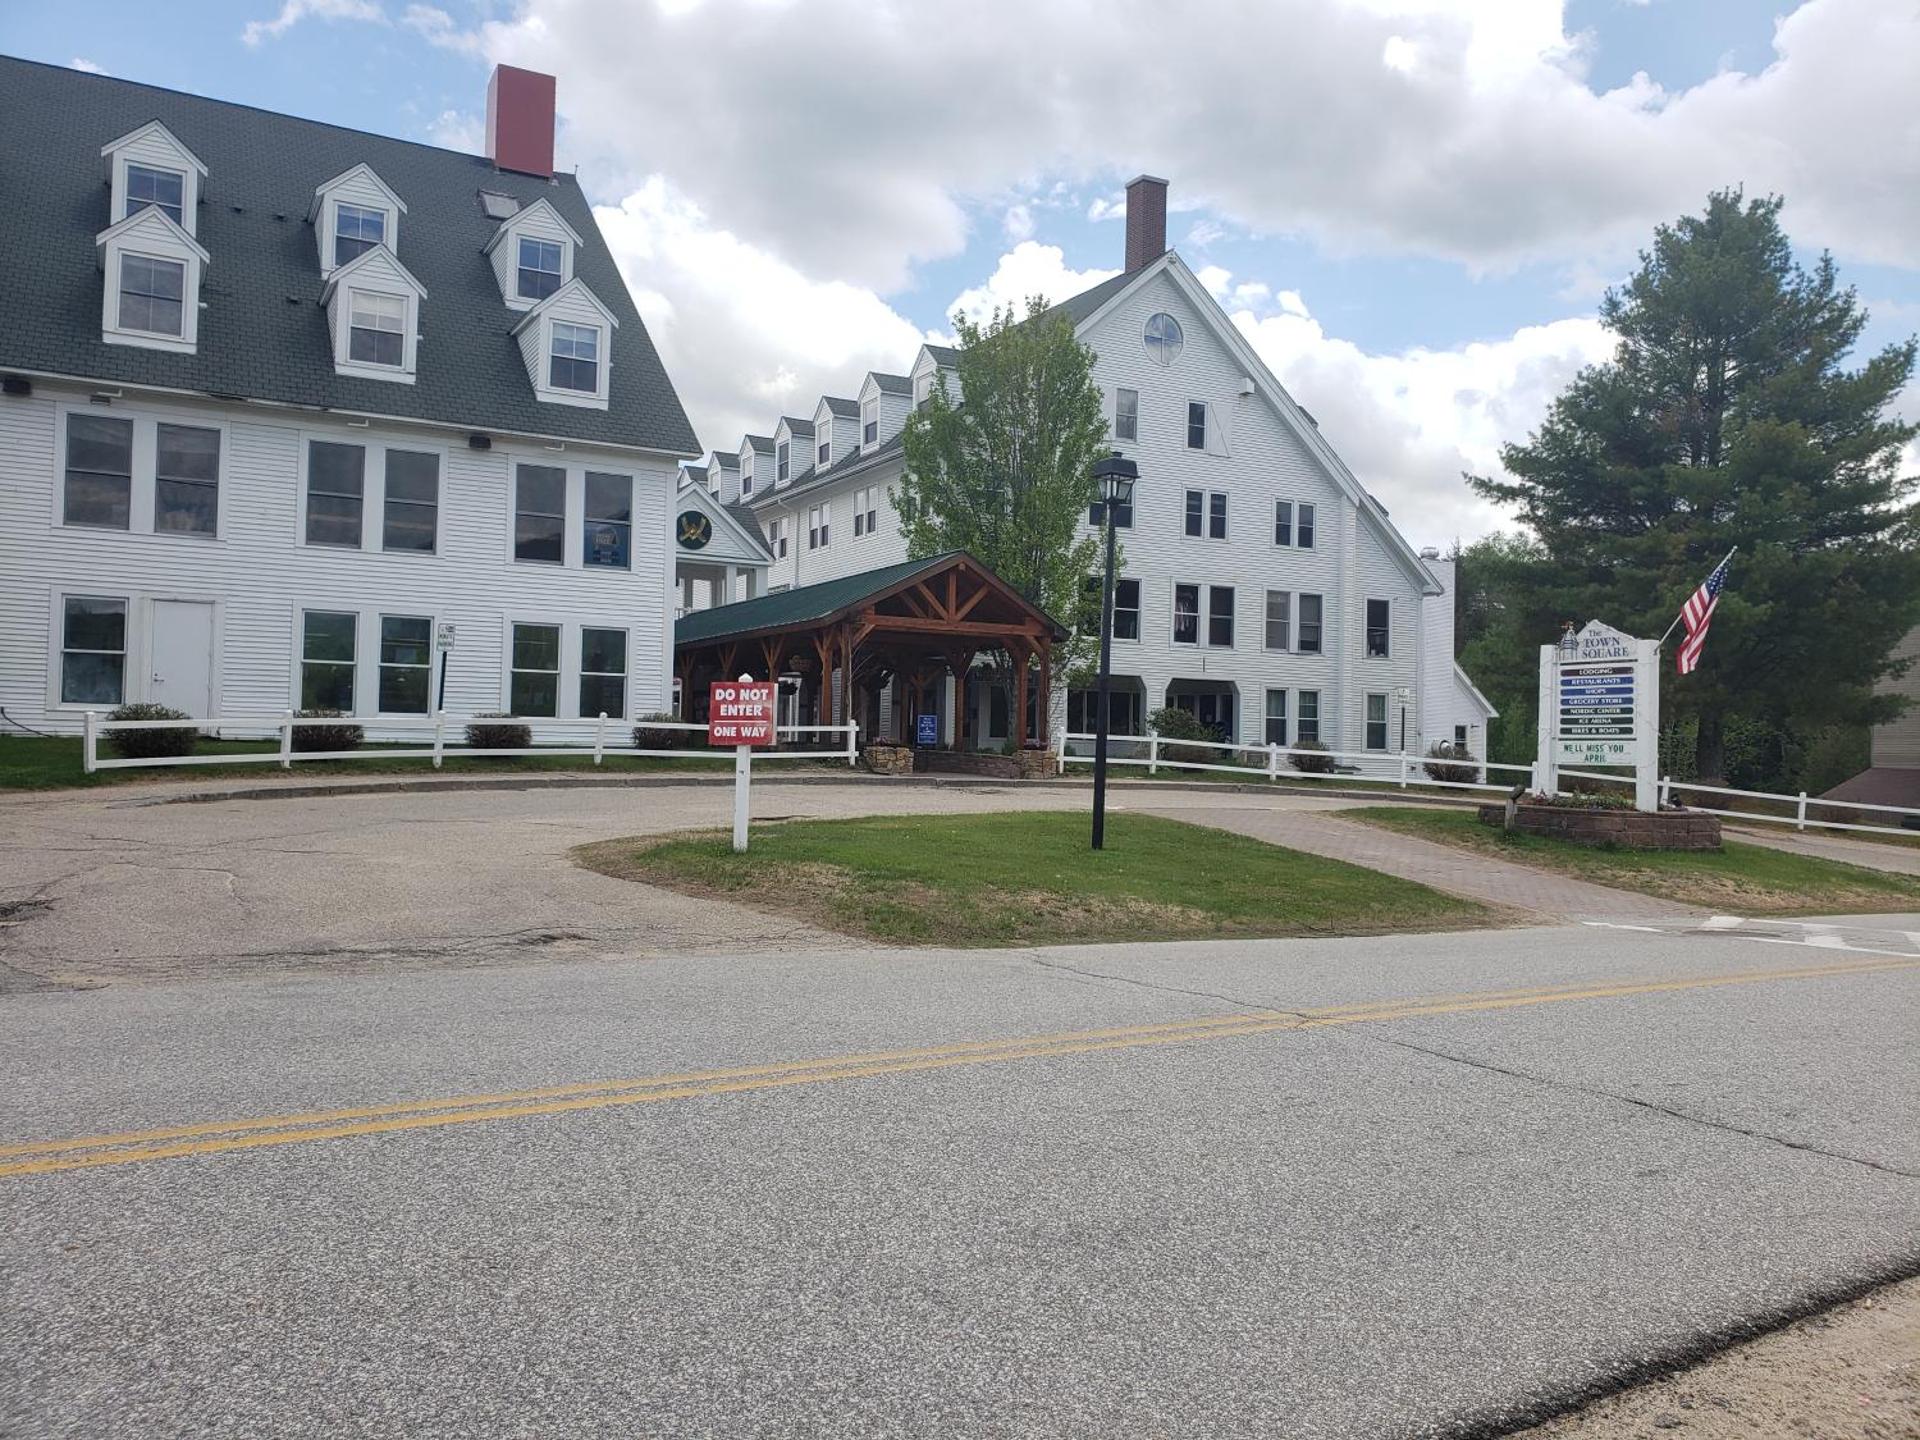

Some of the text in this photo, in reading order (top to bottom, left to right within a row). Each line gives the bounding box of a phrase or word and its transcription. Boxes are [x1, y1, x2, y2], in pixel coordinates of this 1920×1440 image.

[1584, 637, 1620, 648] TOWN
[1582, 648, 1629, 658] SQUARE
[715, 689, 768, 700] DO NOT
[720, 704, 762, 716] ENTER
[714, 727, 767, 737] ONE WAY
[1587, 744, 1604, 752] MISS
[1608, 744, 1624, 752] YOU
[1584, 754, 1607, 762] APRIL
